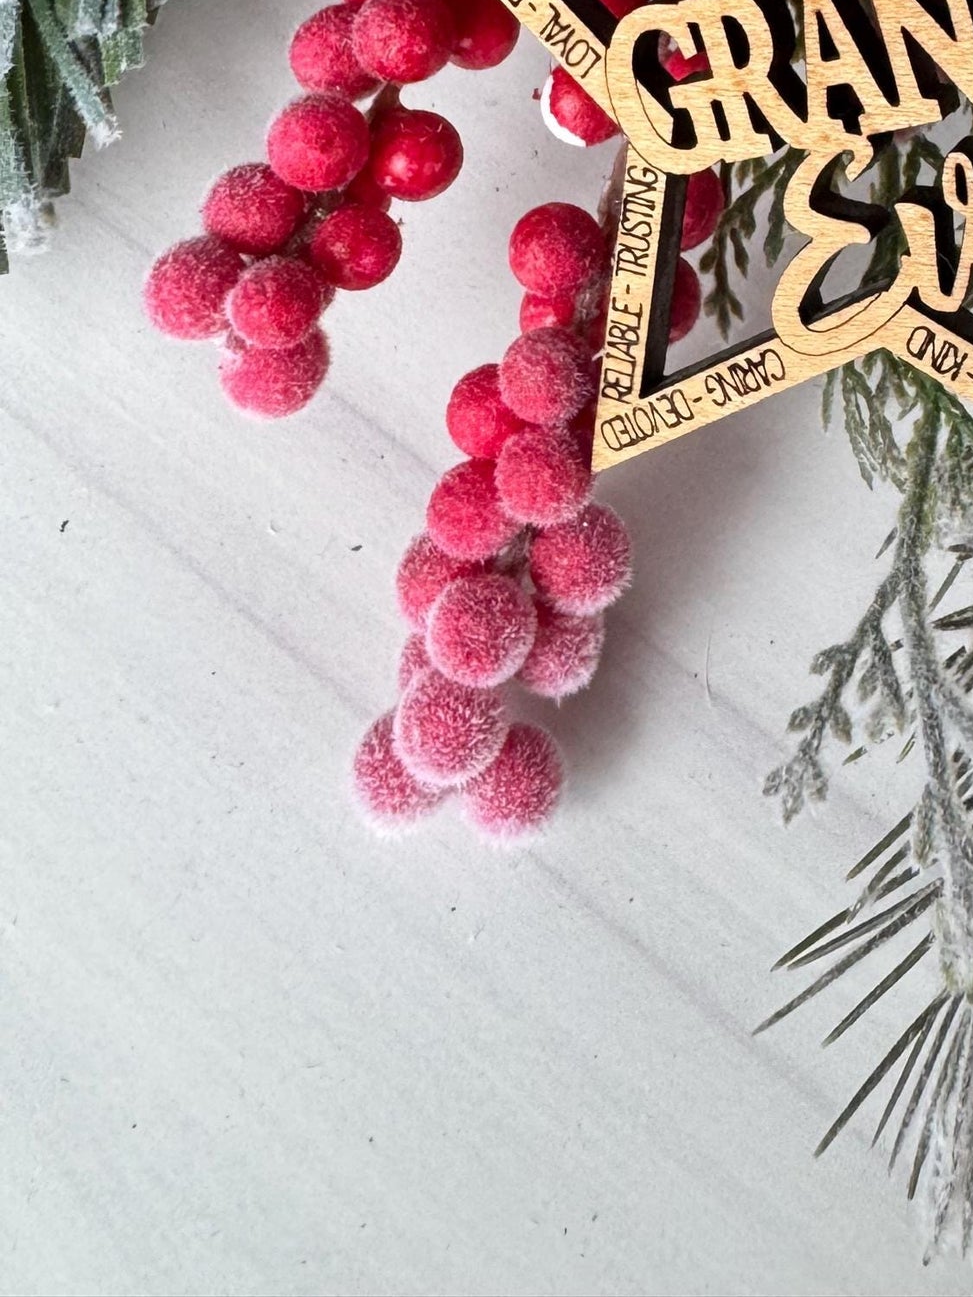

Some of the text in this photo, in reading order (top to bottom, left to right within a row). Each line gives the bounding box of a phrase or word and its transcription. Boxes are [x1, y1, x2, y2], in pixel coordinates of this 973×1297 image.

[539, 2, 602, 79] LOYAL
[601, 165, 659, 404] RELIABLE TRUSTING
[906, 325, 968, 381] KIND
[600, 348, 786, 452] CARING DEVOTED
